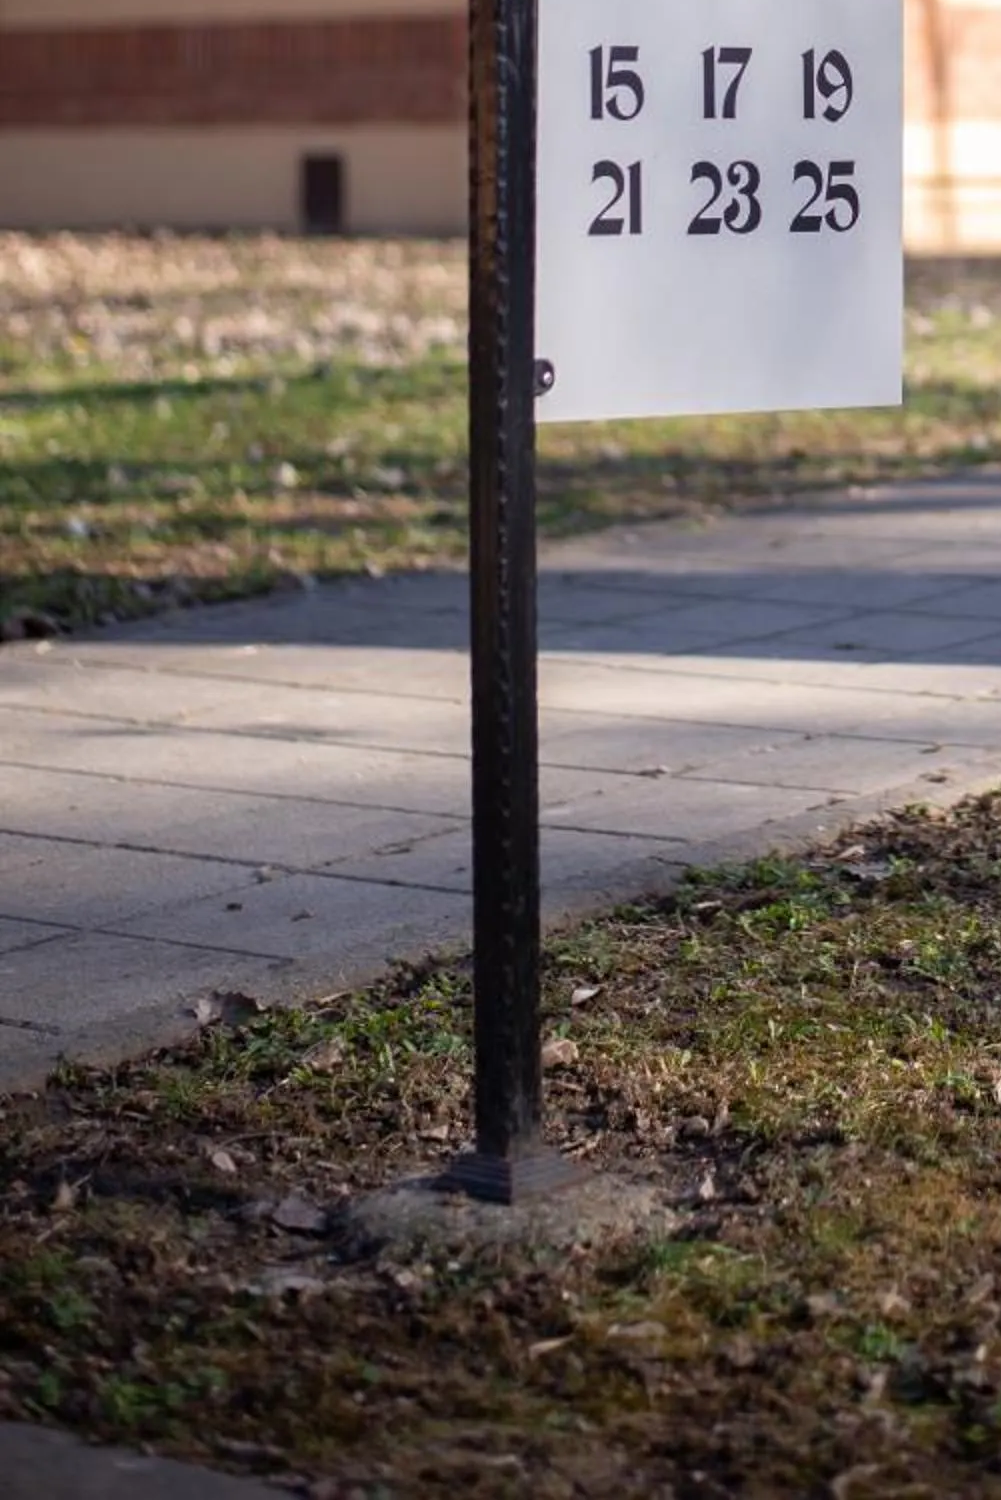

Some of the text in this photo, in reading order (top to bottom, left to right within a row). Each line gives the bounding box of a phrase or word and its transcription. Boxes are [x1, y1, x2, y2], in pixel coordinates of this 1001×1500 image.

[588, 45, 853, 123] 15 17 19
[588, 159, 860, 236] 21 23 25
